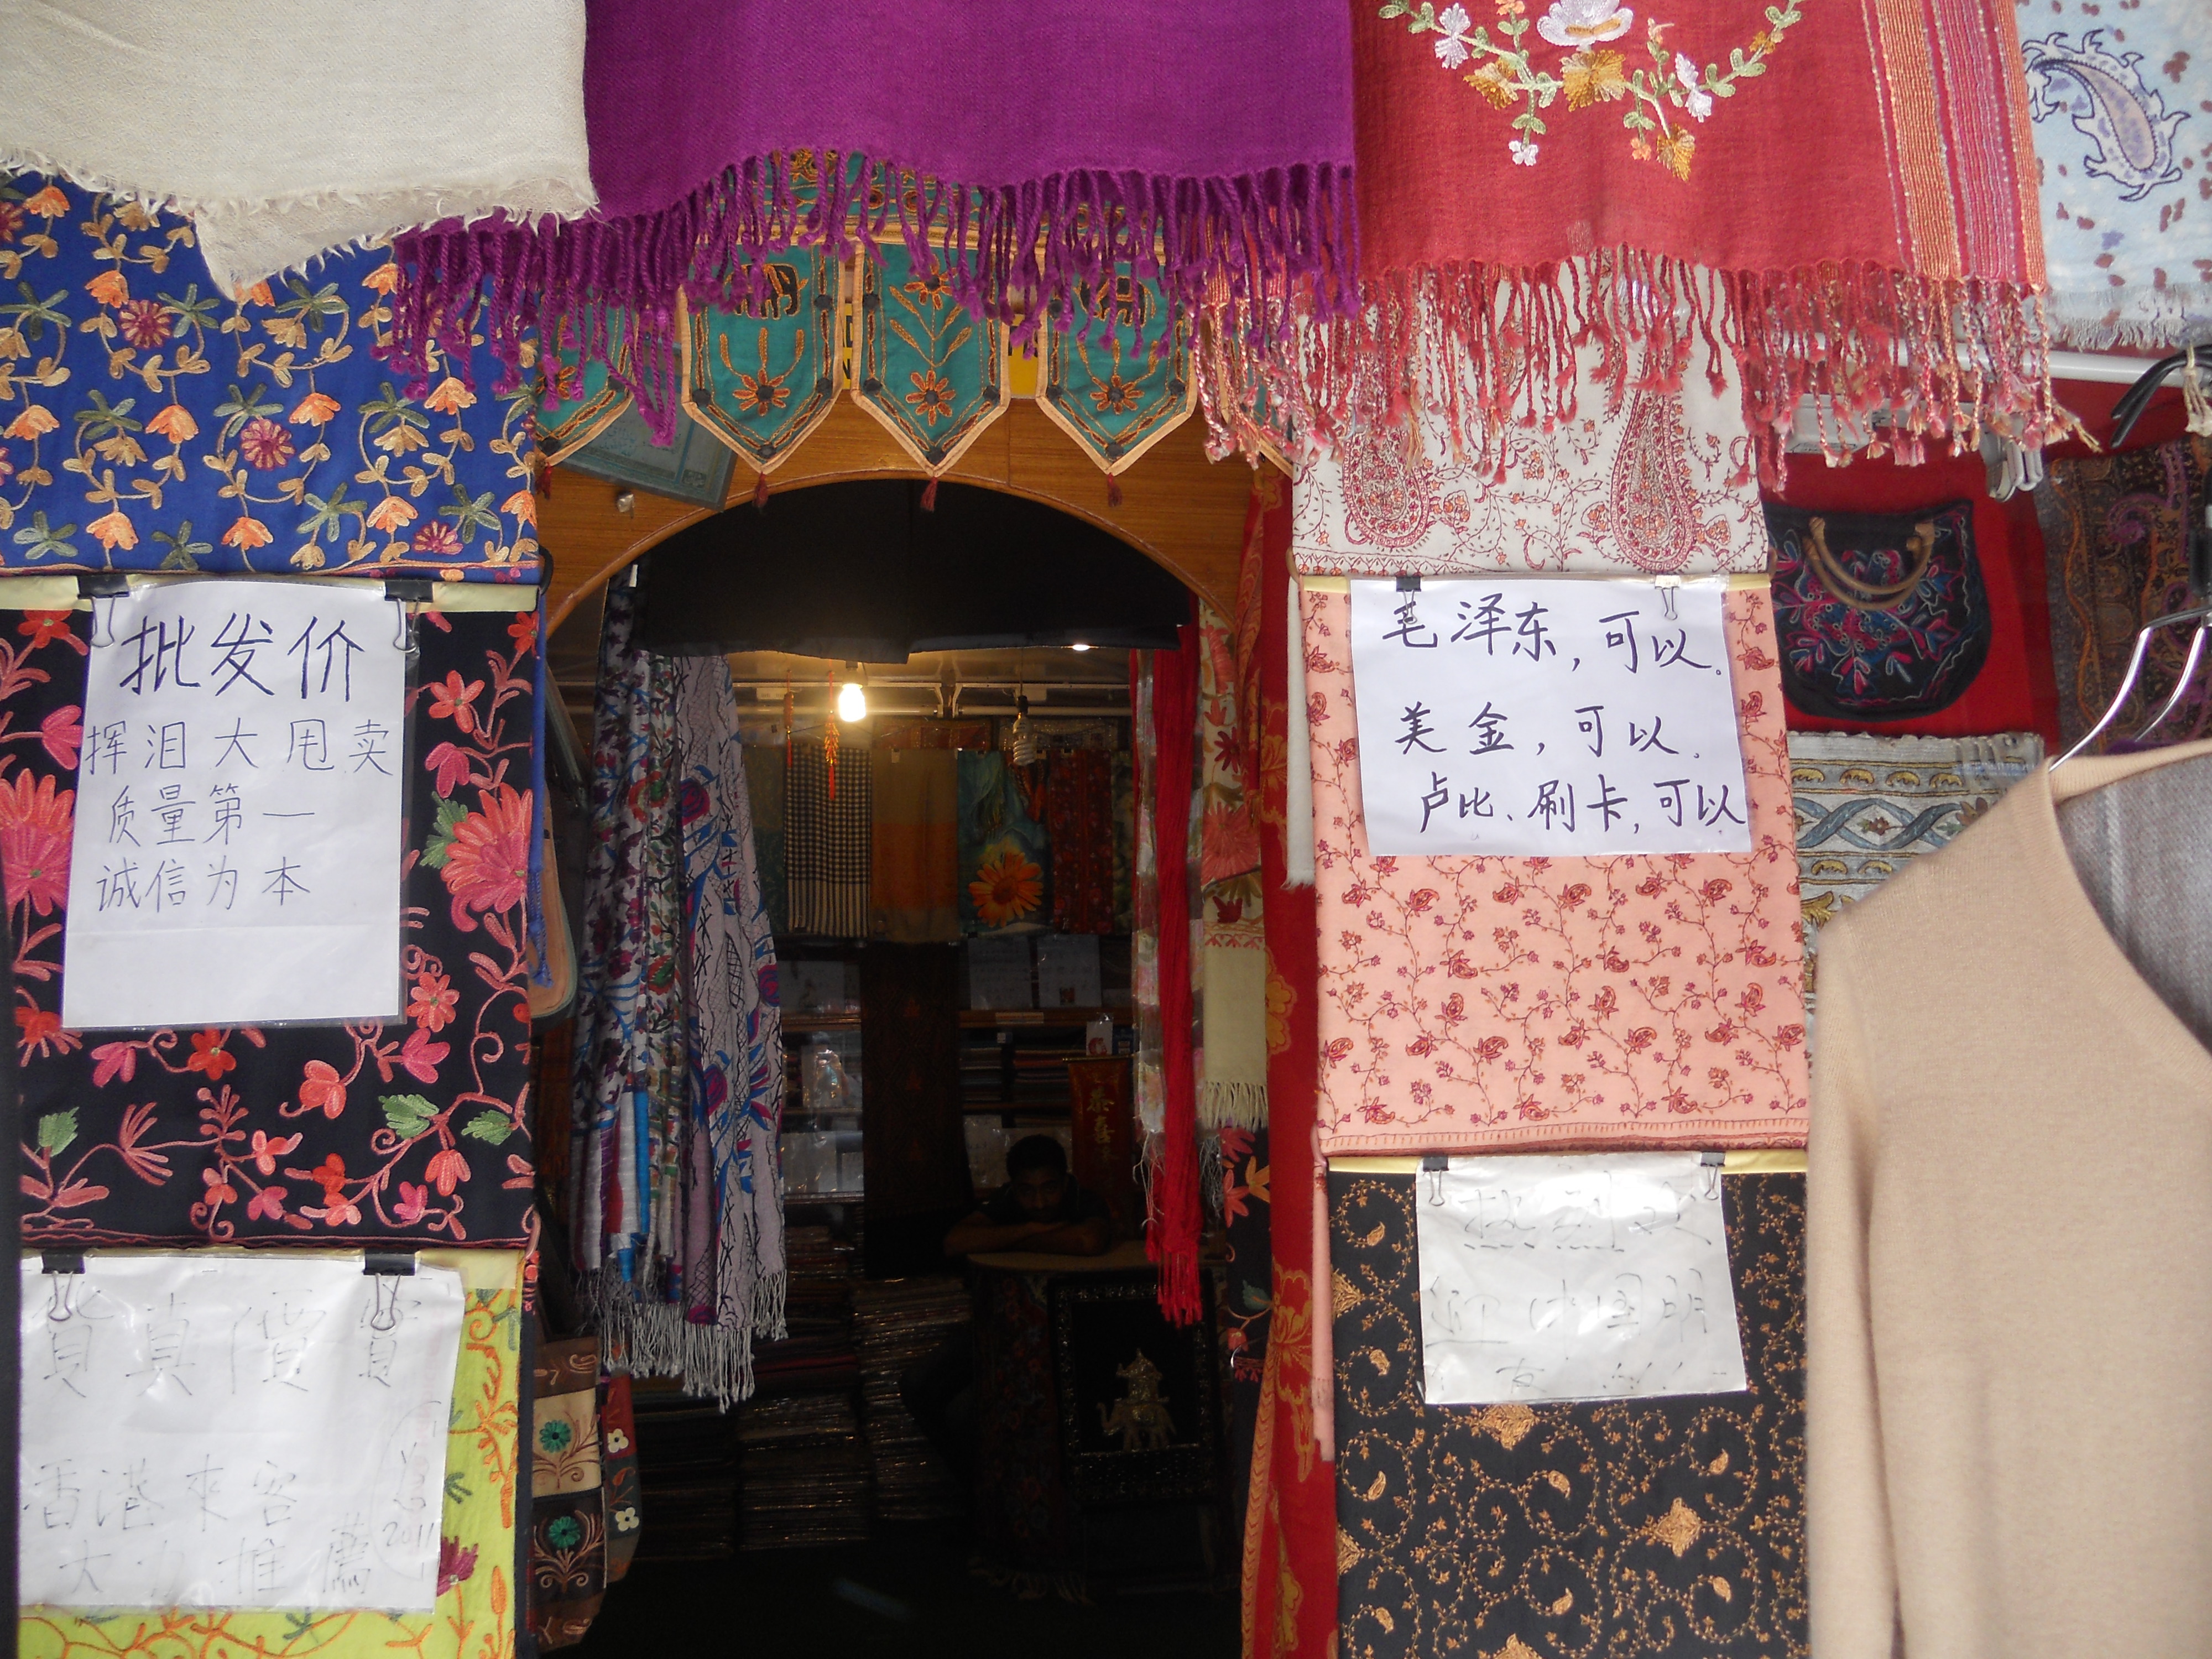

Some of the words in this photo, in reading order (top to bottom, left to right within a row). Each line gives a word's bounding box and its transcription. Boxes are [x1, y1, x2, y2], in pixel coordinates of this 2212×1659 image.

[119, 612, 365, 703] 批发价
[85, 717, 393, 776] 挥泪大甩卖
[109, 784, 315, 847] 质量第一
[96, 855, 311, 913] 诚信为本
